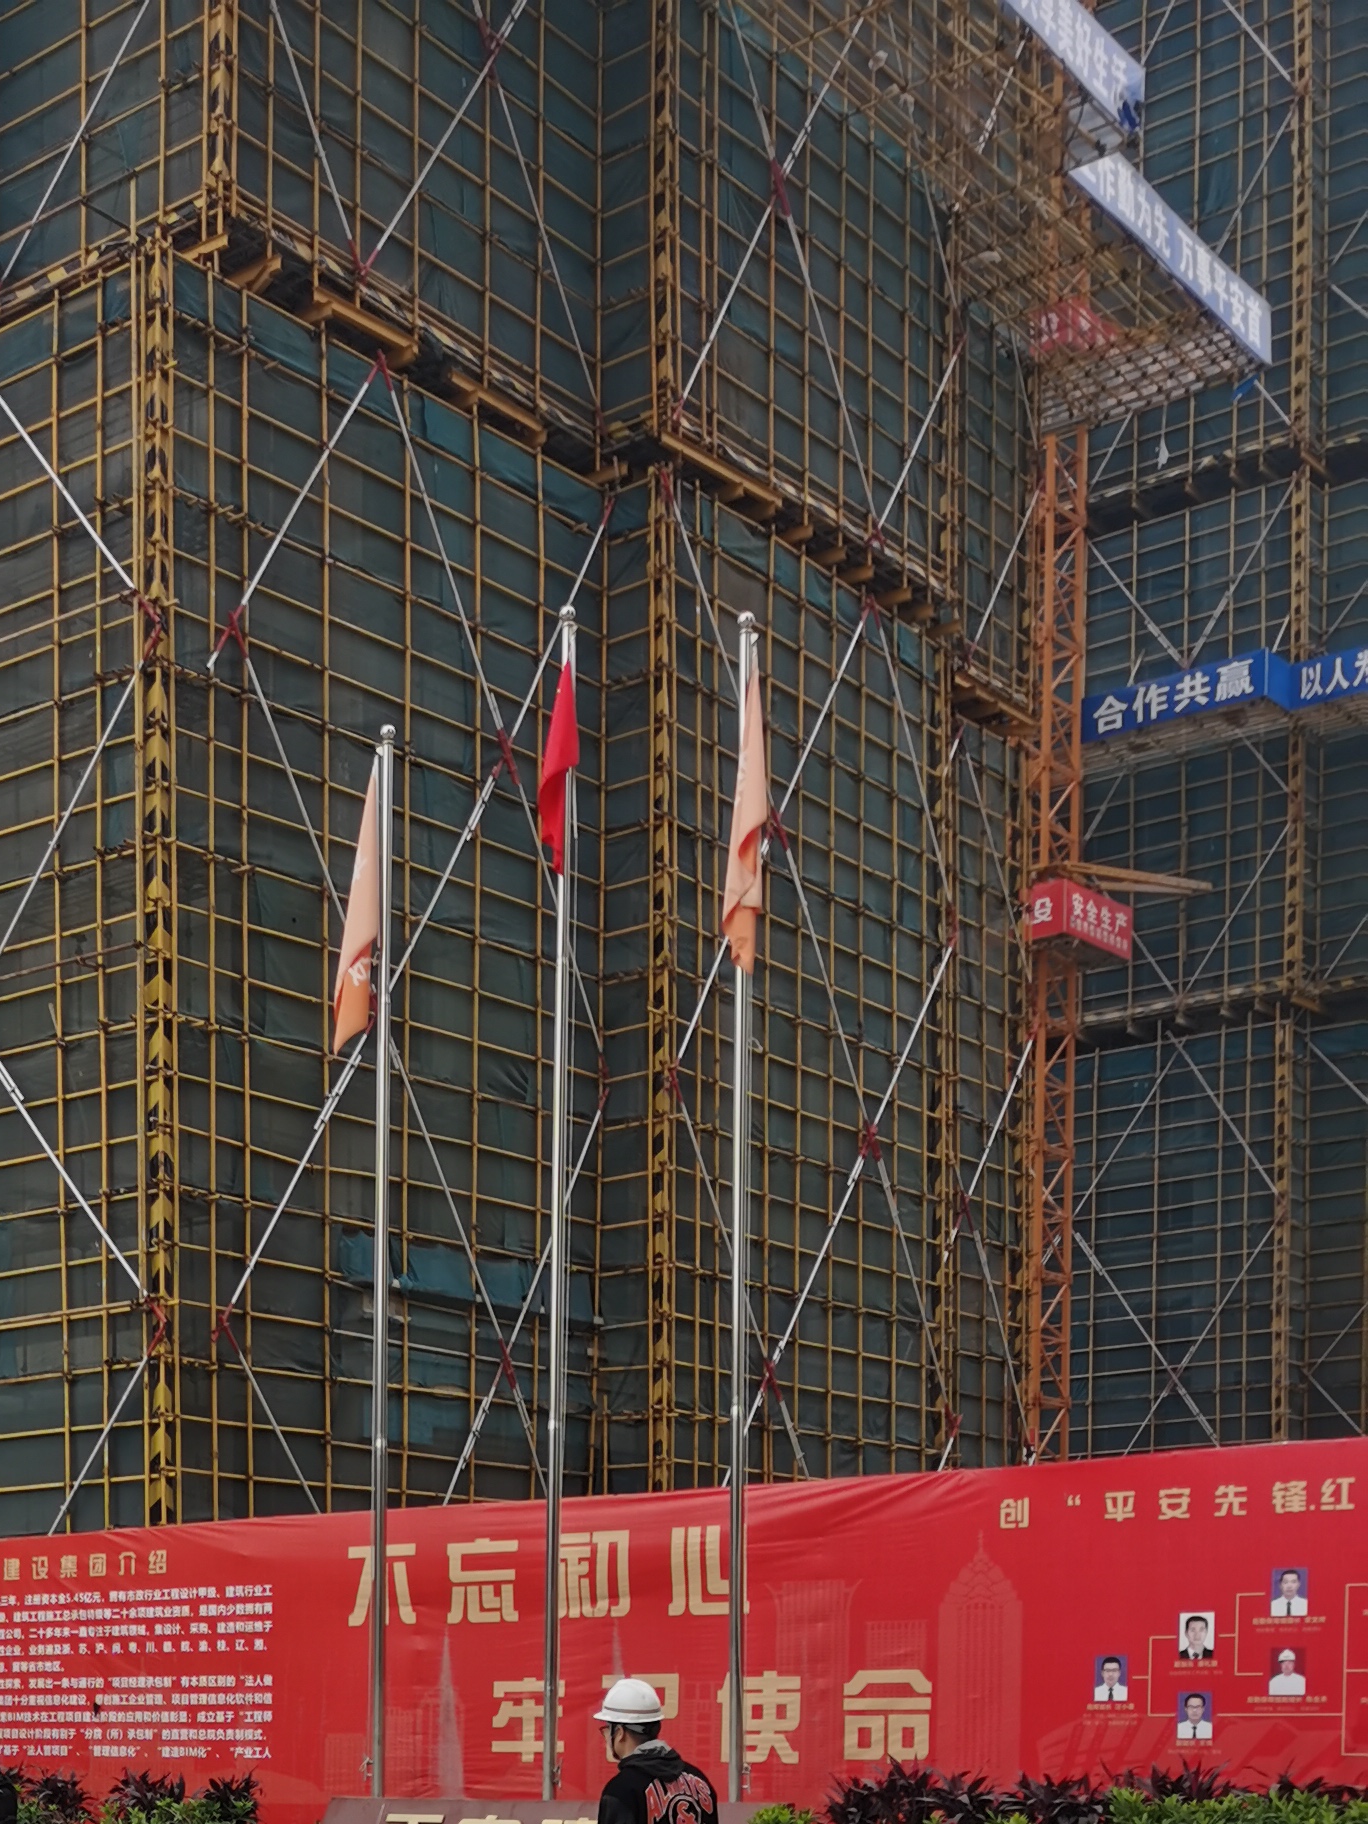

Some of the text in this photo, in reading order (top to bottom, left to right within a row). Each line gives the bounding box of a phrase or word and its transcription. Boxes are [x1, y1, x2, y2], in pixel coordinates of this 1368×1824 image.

[1093, 658, 1255, 734] 合作共赢
[1072, 893, 1128, 935] 安全生产
[347, 1524, 750, 1627] 不忘初心
[491, 1668, 932, 1764] 牢使命
